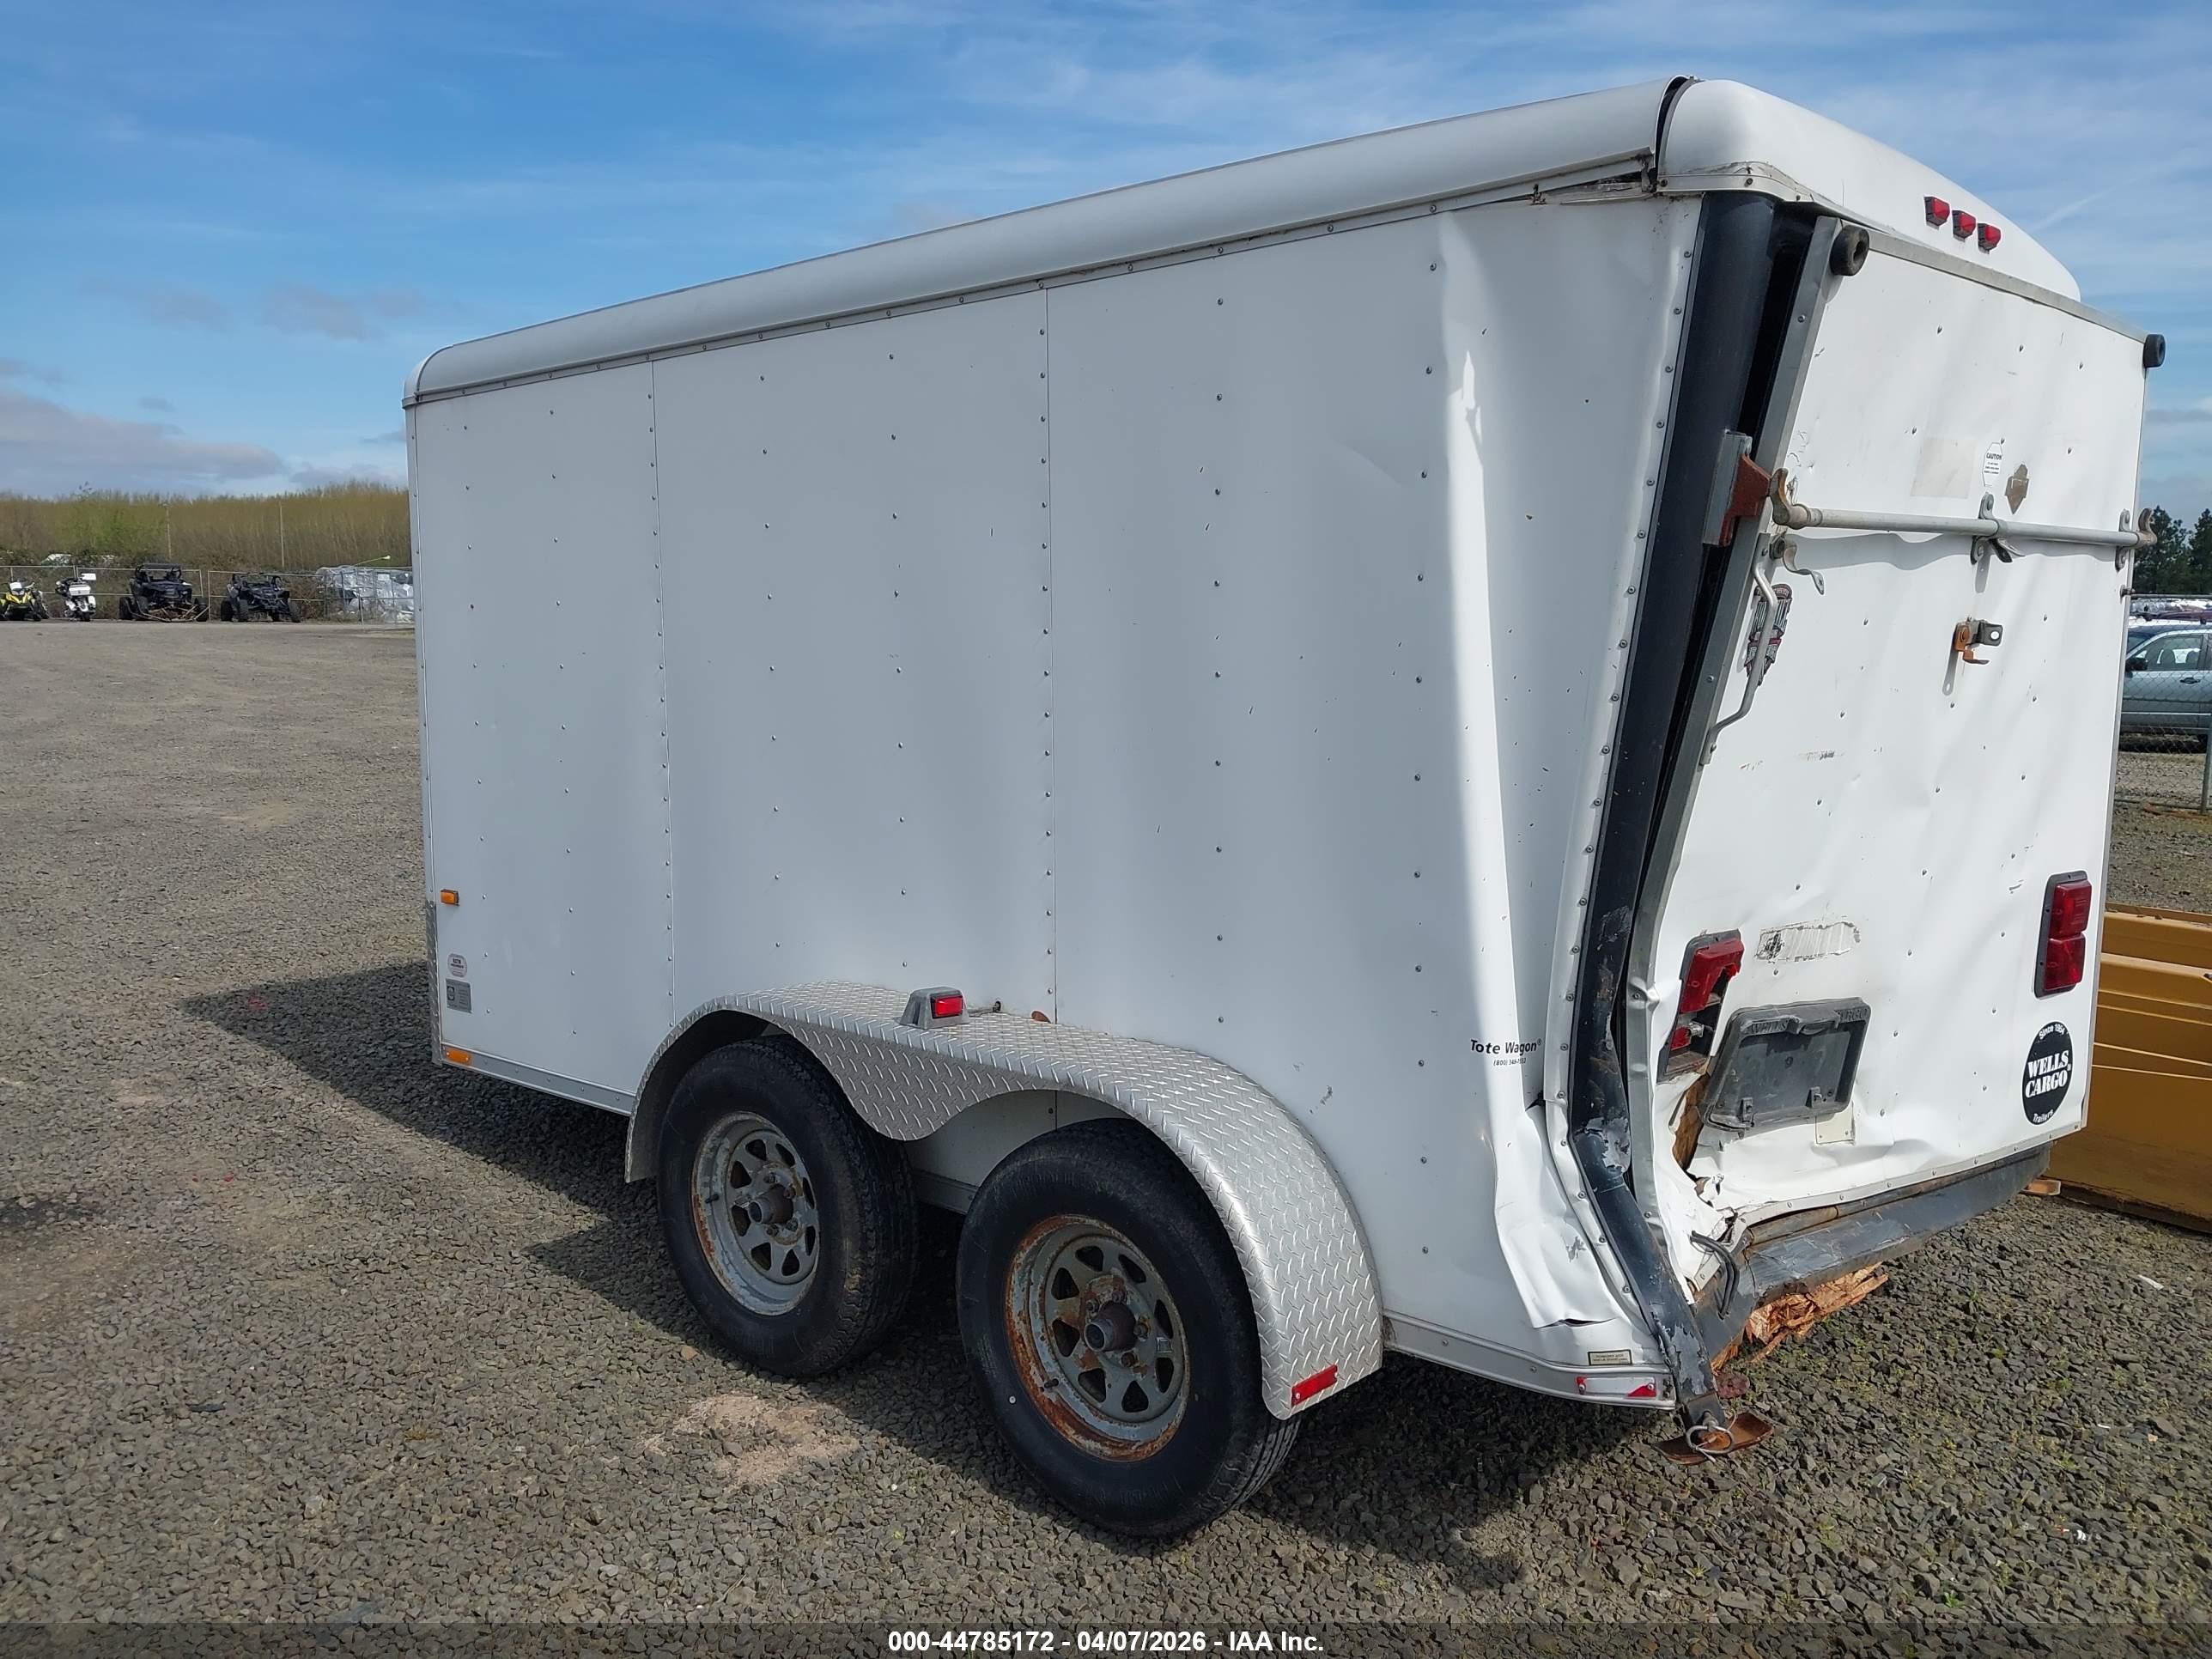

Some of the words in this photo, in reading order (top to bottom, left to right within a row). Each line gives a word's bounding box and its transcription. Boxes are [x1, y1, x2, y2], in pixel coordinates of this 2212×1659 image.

[2039, 1025, 2054, 1040] Since
[1470, 1039, 1501, 1054] Tote
[2027, 1050, 2069, 1079] WELLS
[2025, 1070, 2068, 1097] CARGO
